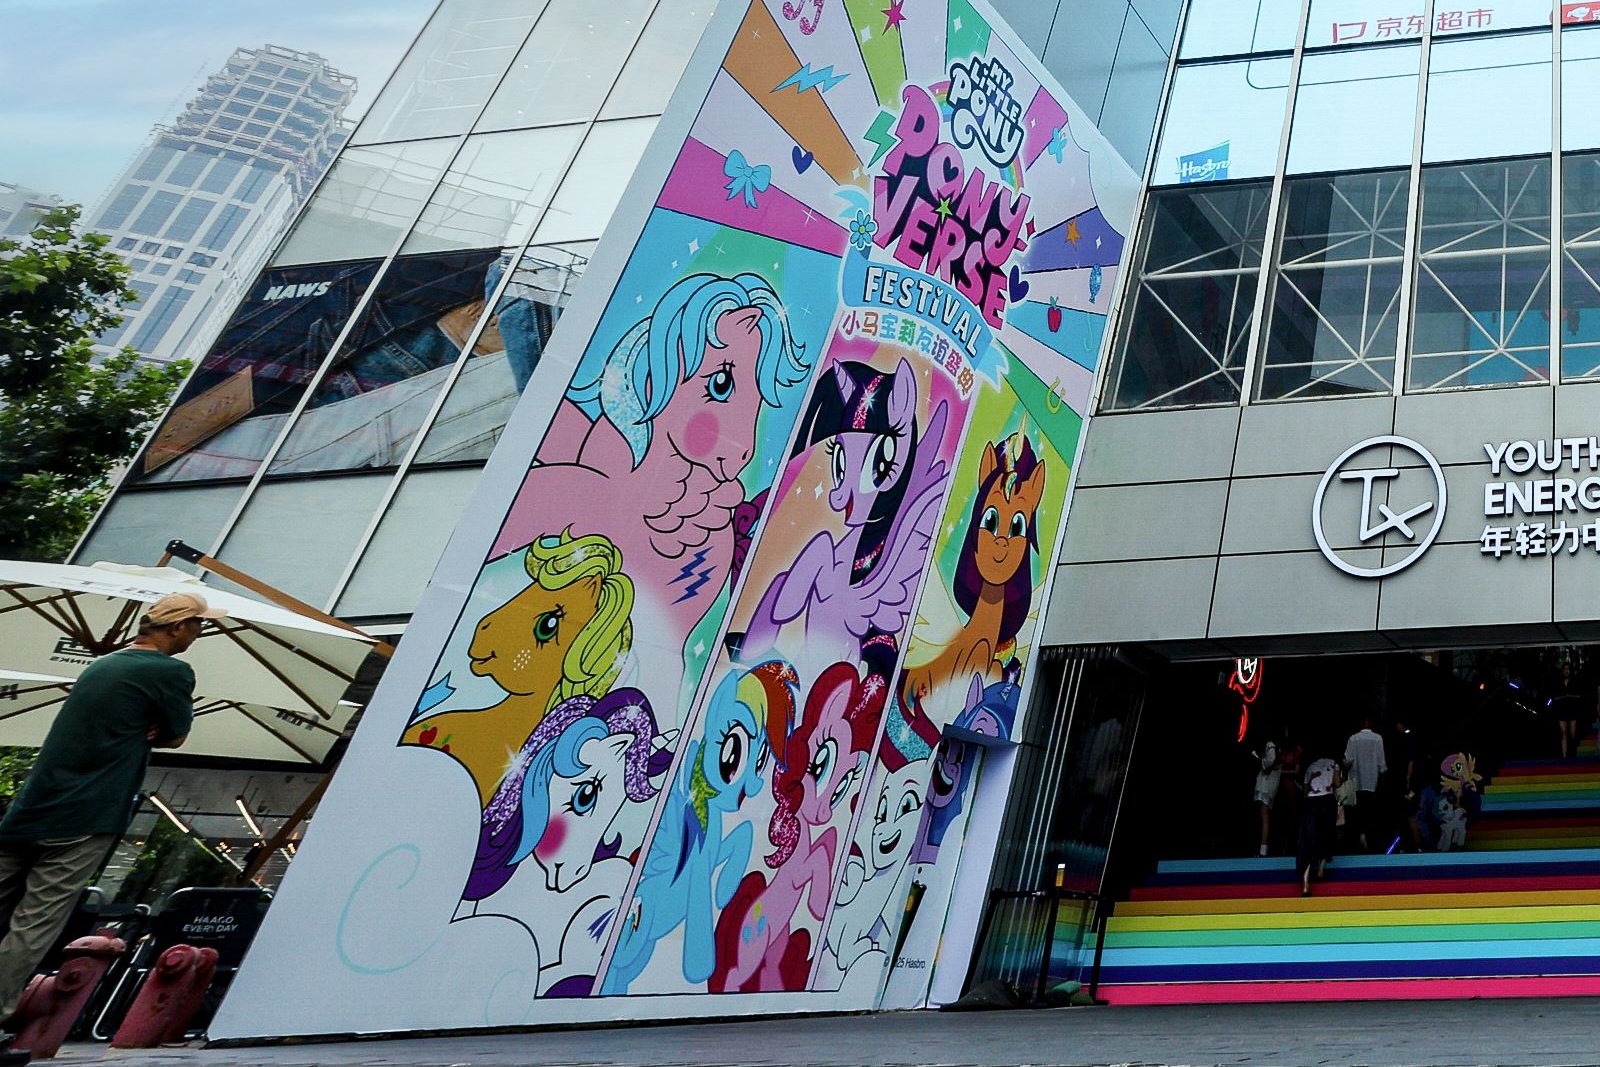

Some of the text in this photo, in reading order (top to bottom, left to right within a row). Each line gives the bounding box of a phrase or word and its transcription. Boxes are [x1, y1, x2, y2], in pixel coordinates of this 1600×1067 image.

[1375, 8, 1494, 37] 京东超市
[948, 67, 1022, 166] PONY
[990, 62, 1012, 91] MY
[882, 84, 1031, 267] PONY
[1174, 159, 1231, 178] Hasbro
[873, 174, 1008, 330] VERSE
[842, 310, 974, 395] 小马宝莉友谊盛典
